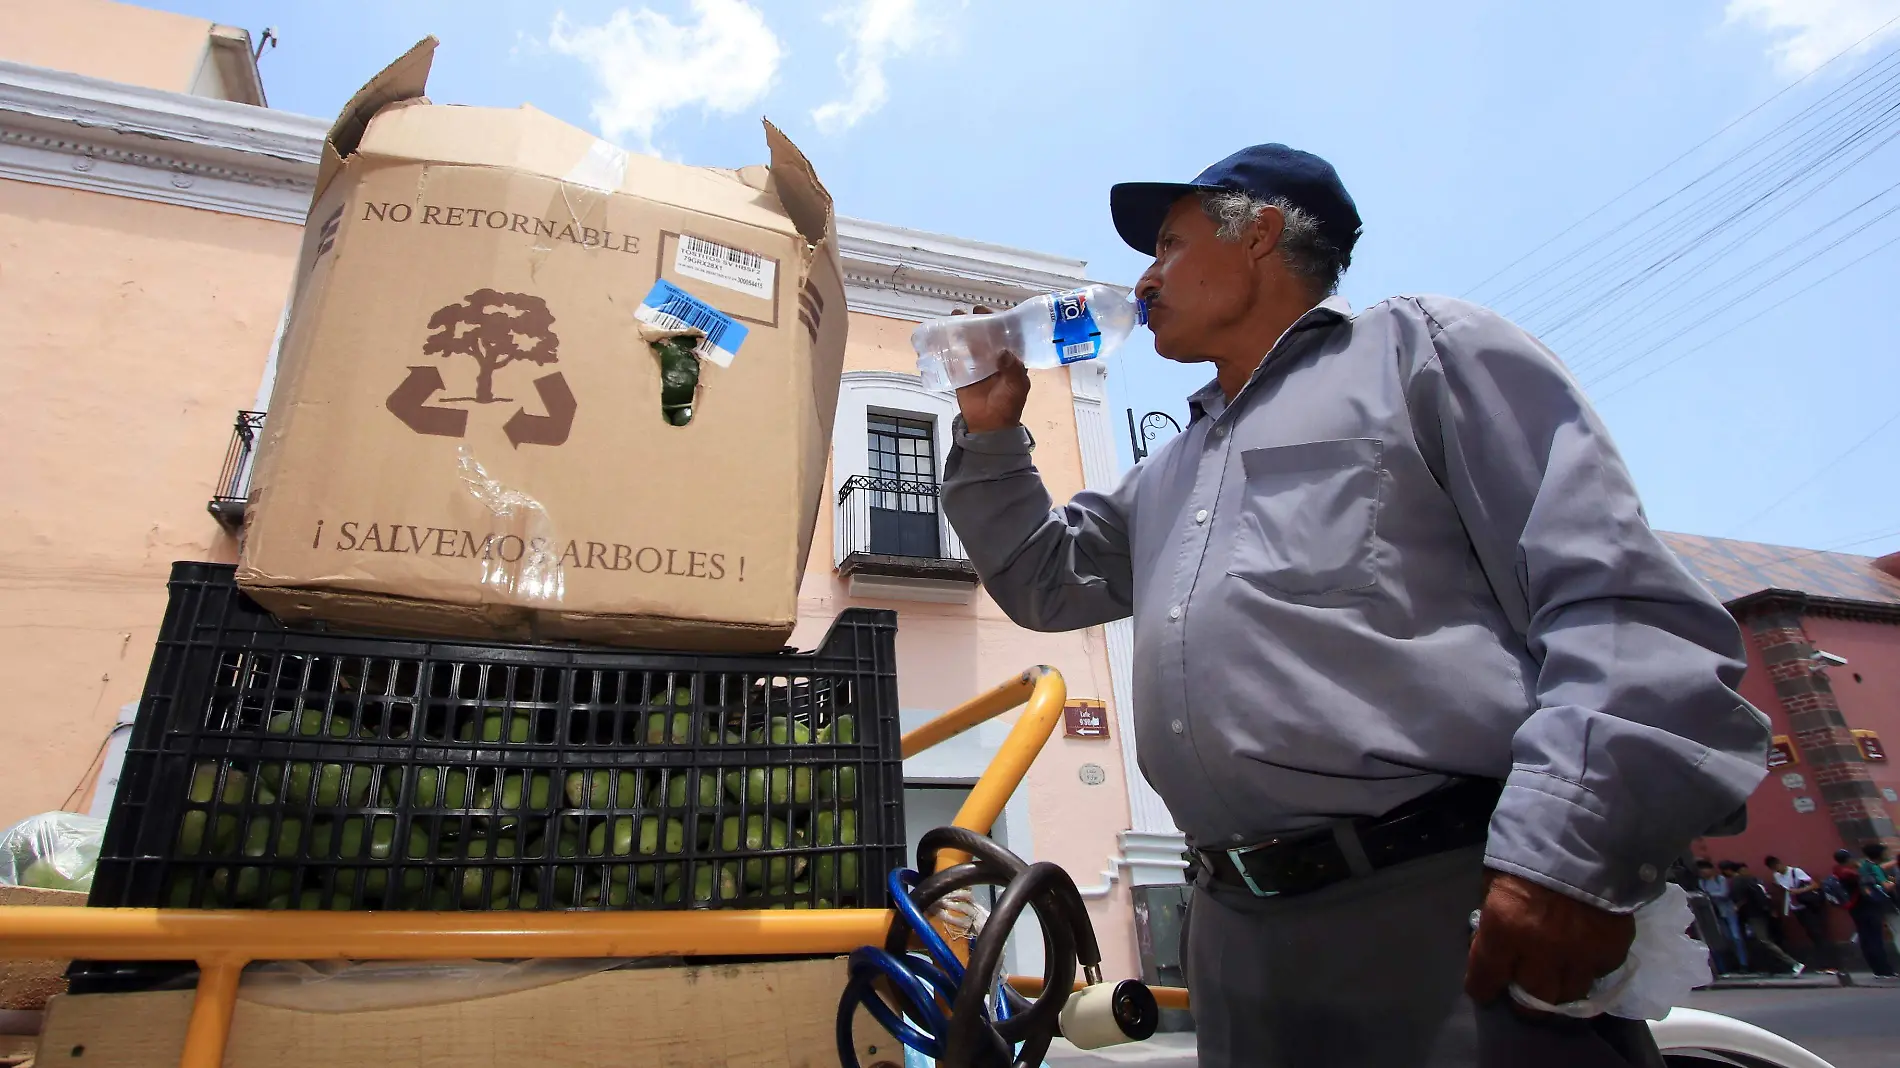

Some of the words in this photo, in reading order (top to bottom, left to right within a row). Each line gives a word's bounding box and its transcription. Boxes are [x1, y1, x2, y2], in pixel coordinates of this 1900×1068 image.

[362, 201, 412, 223] NO
[420, 204, 640, 255] RETORNABLE
[681, 247, 720, 263] TOSTITOS
[336, 521, 546, 564] SALVEMOS
[557, 539, 726, 580] ARBOLES
